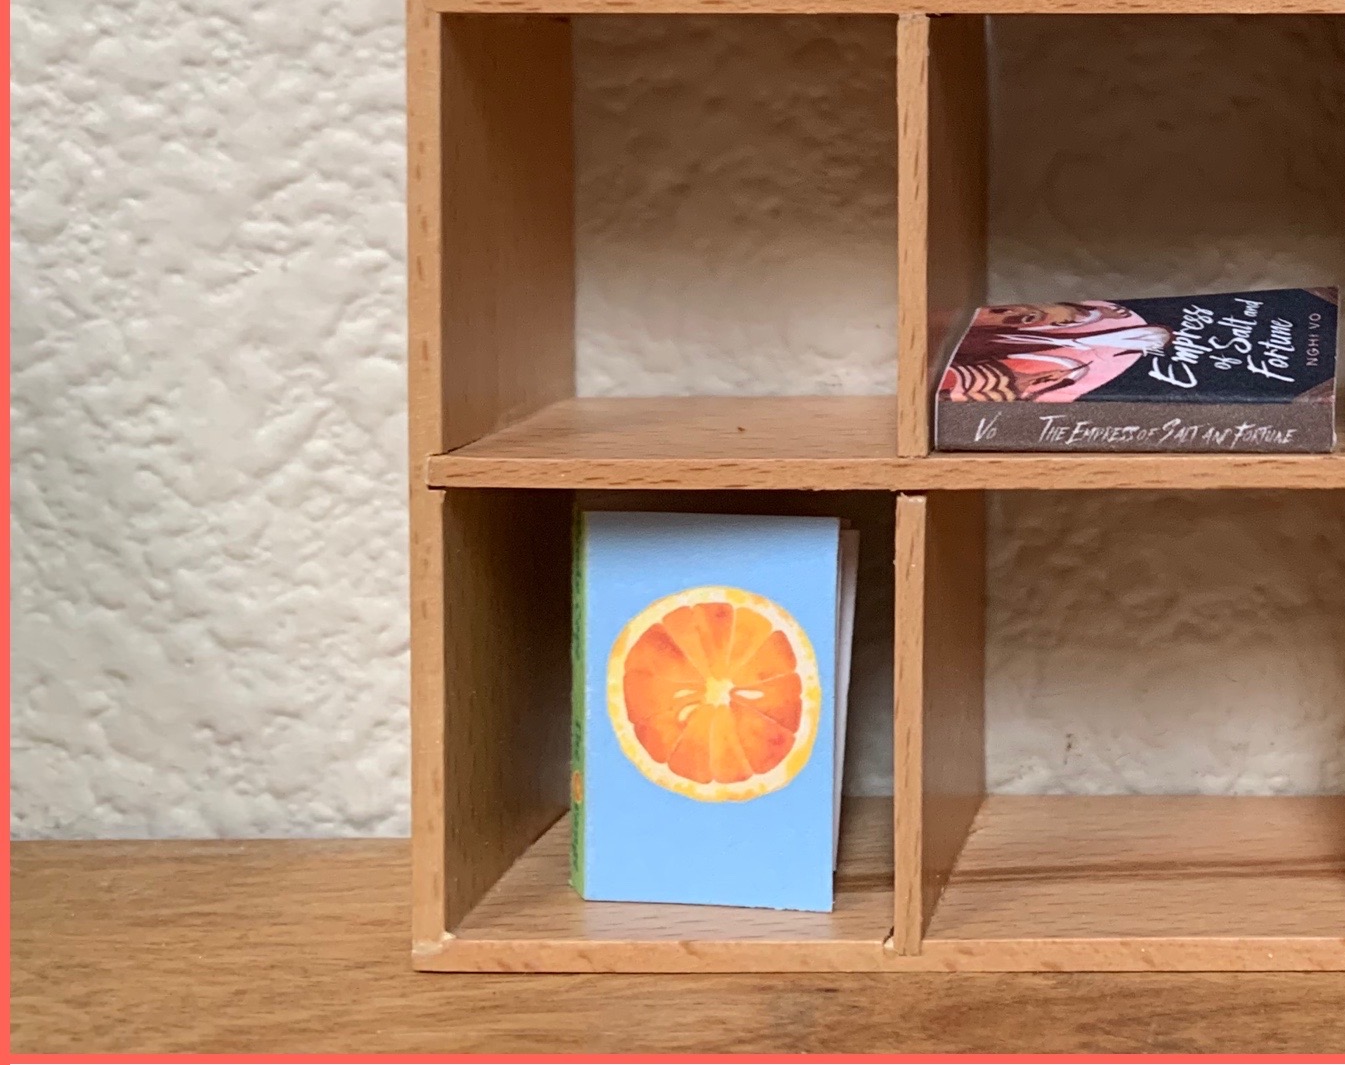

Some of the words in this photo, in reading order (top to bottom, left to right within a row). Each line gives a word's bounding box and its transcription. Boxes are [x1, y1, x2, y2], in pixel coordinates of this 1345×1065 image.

[1234, 298, 1264, 317] and
[1308, 313, 1322, 330] VO
[1148, 304, 1214, 388] Empress
[1208, 315, 1258, 354] Salt
[1247, 317, 1295, 382] Fortune
[1306, 334, 1320, 366] NGHI
[1209, 353, 1243, 370] of
